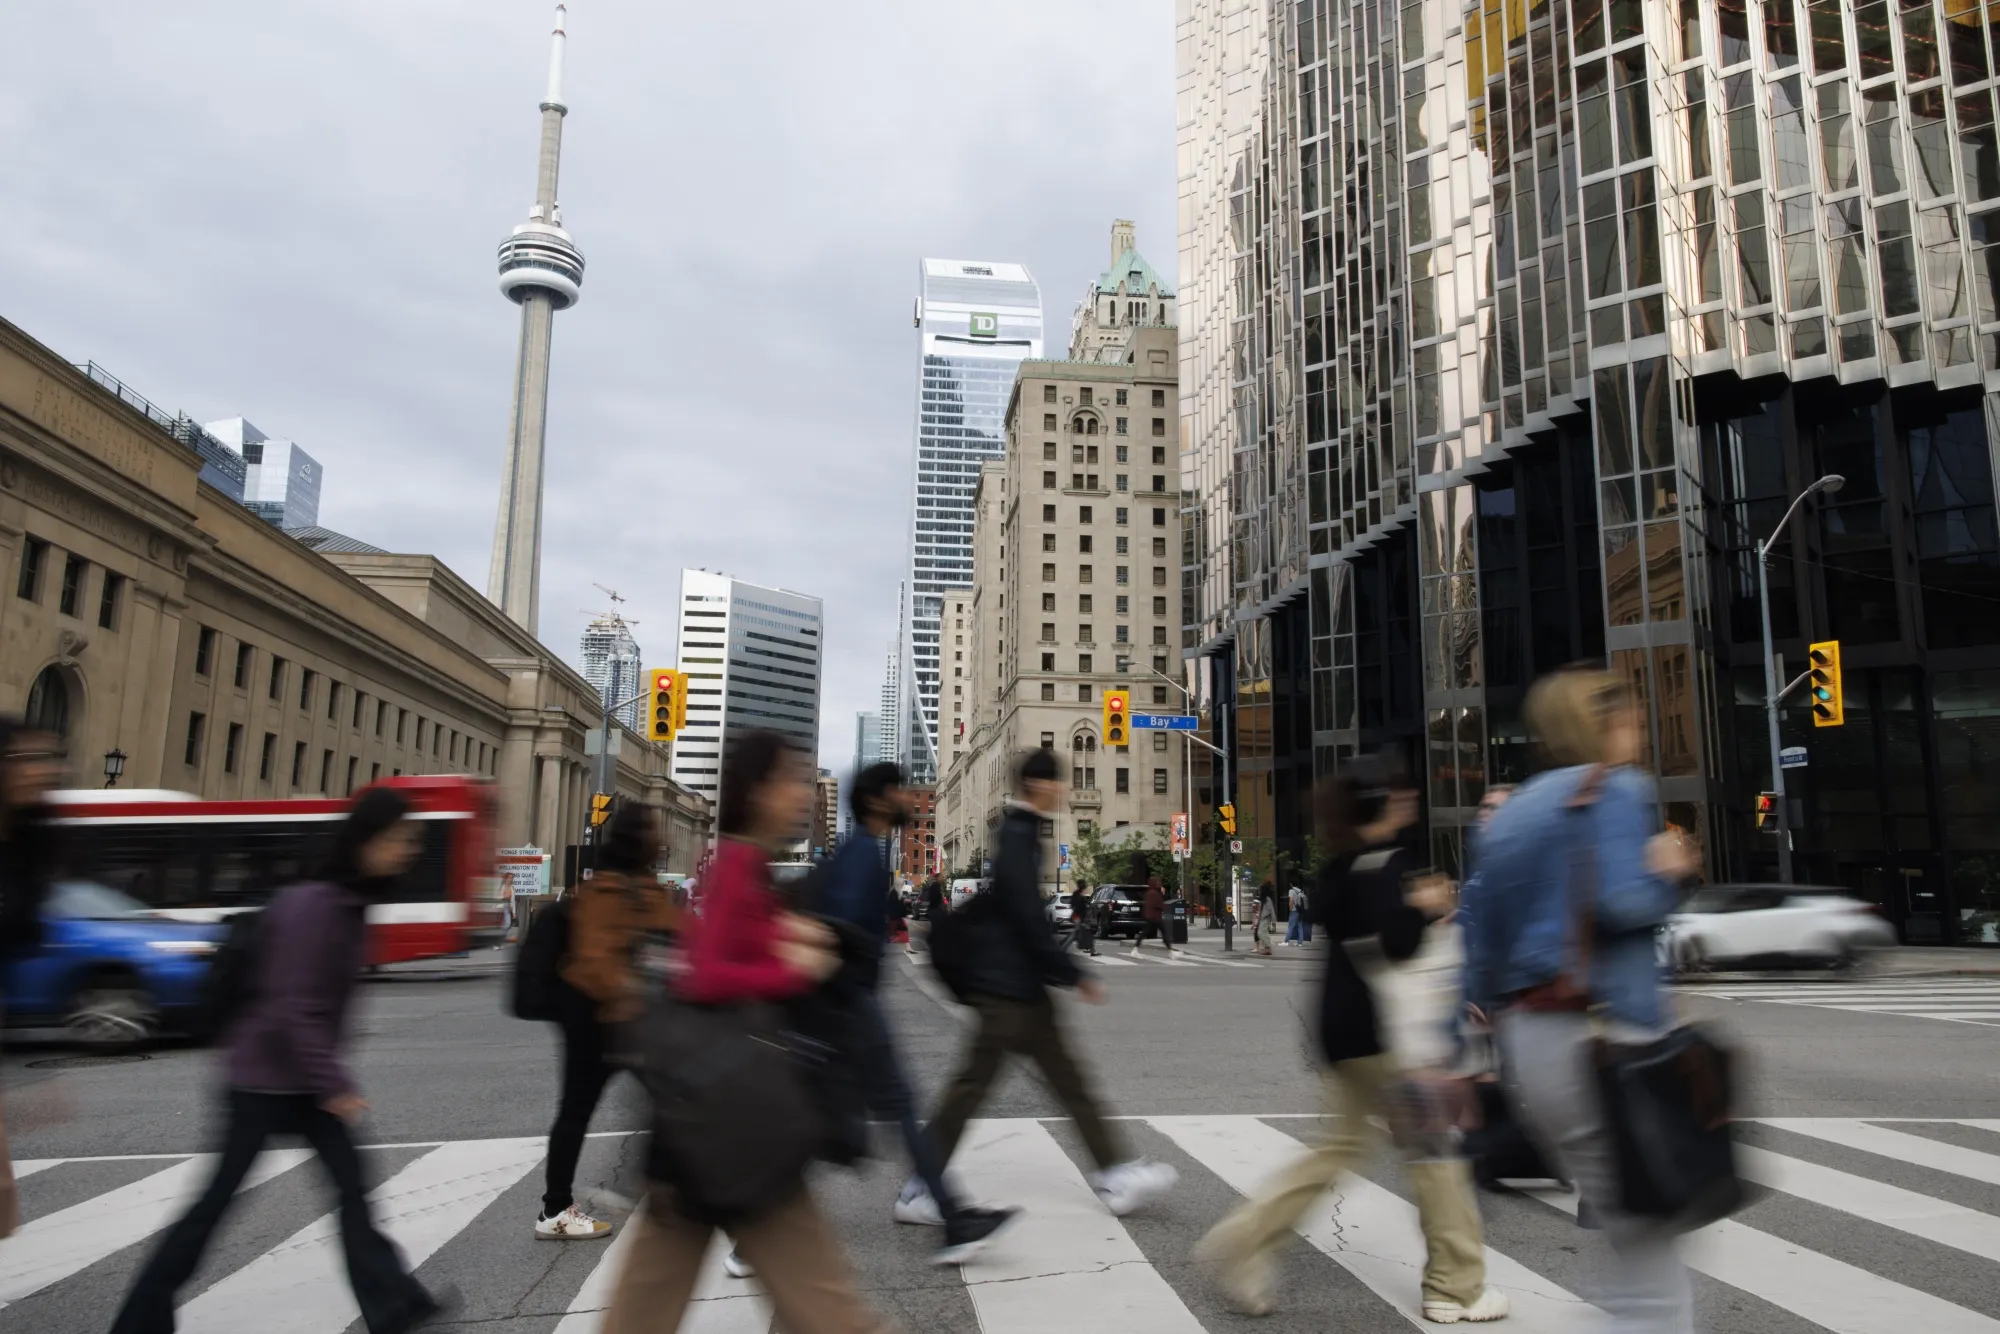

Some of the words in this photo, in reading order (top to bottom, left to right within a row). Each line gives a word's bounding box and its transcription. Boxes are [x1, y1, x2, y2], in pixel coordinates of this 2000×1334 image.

[973, 316, 995, 331] TD
[24, 481, 72, 514] POSTAL
[81, 507, 128, 542] STATION
[1150, 716, 1170, 728] Bay
